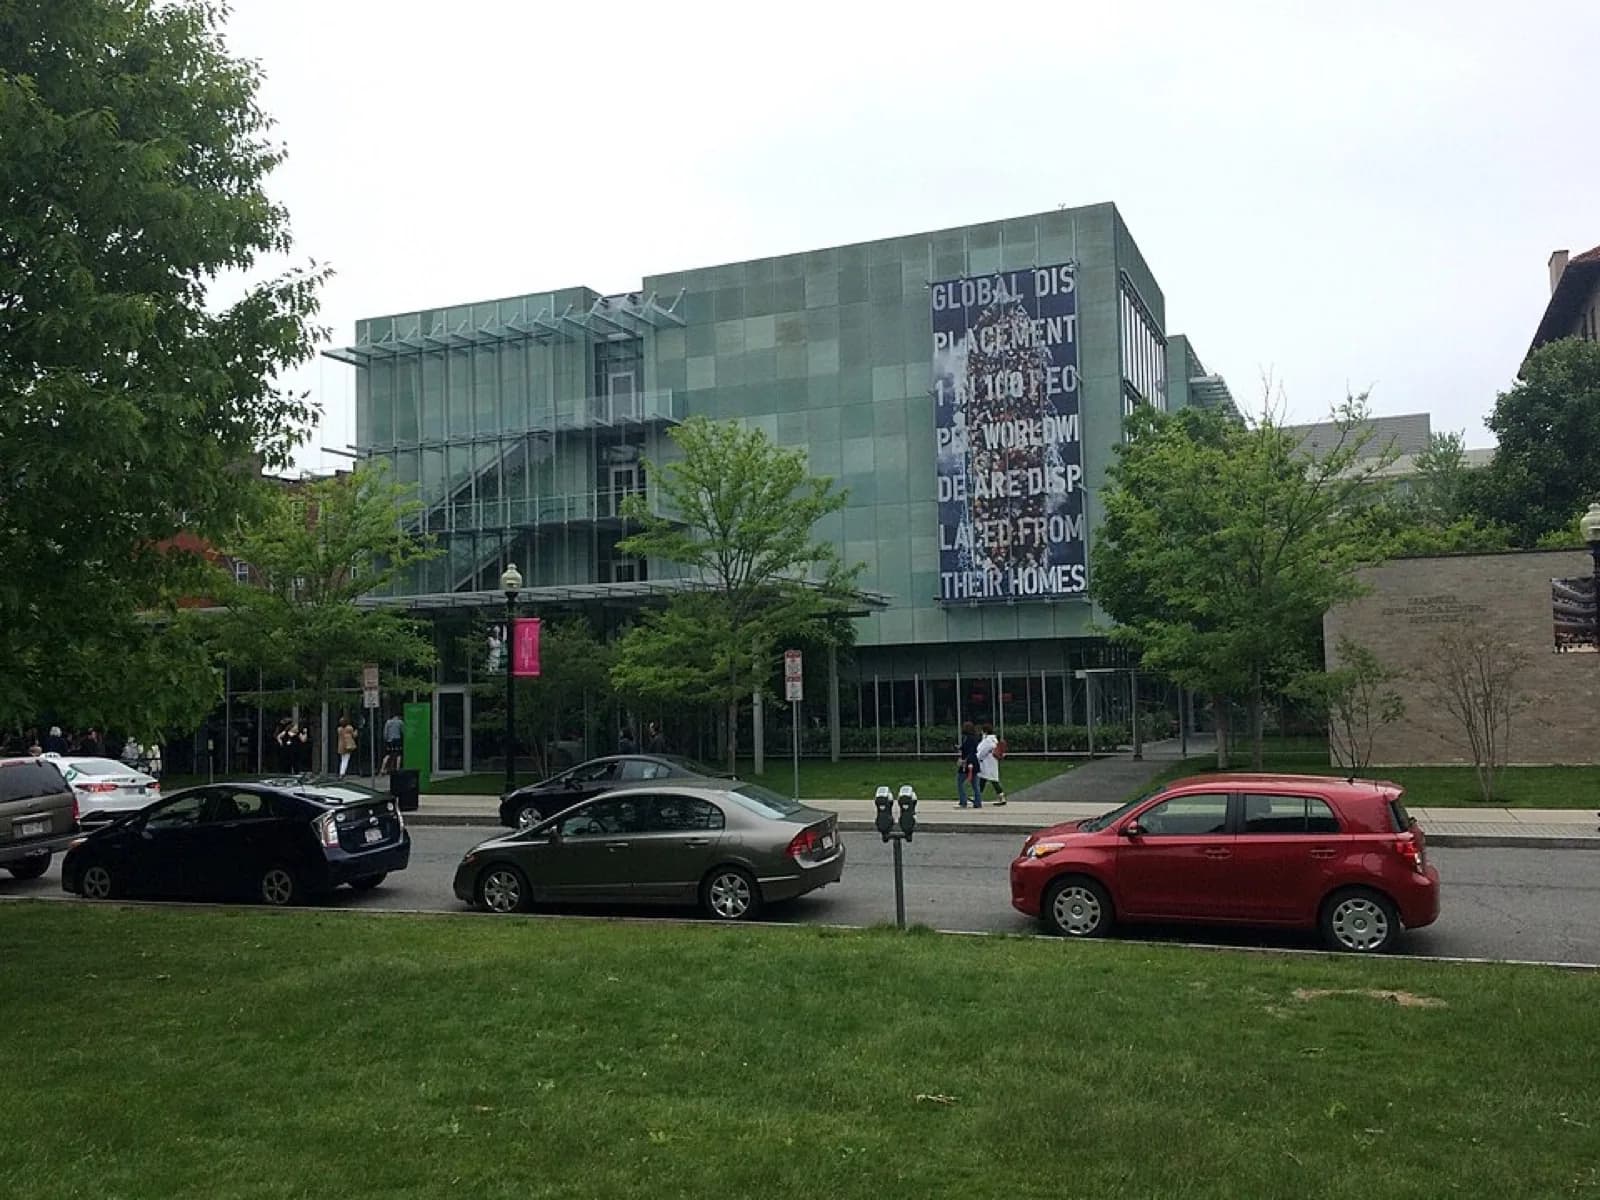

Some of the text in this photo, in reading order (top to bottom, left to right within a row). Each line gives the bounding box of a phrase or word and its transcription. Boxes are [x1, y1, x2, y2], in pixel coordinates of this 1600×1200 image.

[932, 266, 1075, 311] GLOBAL DIS
[933, 315, 1076, 356] PLACEMENT
[936, 380, 944, 407] 1
[975, 470, 1022, 499] ARE
[1018, 514, 1084, 547] FROM
[942, 564, 1086, 599] THEIR HOMES
